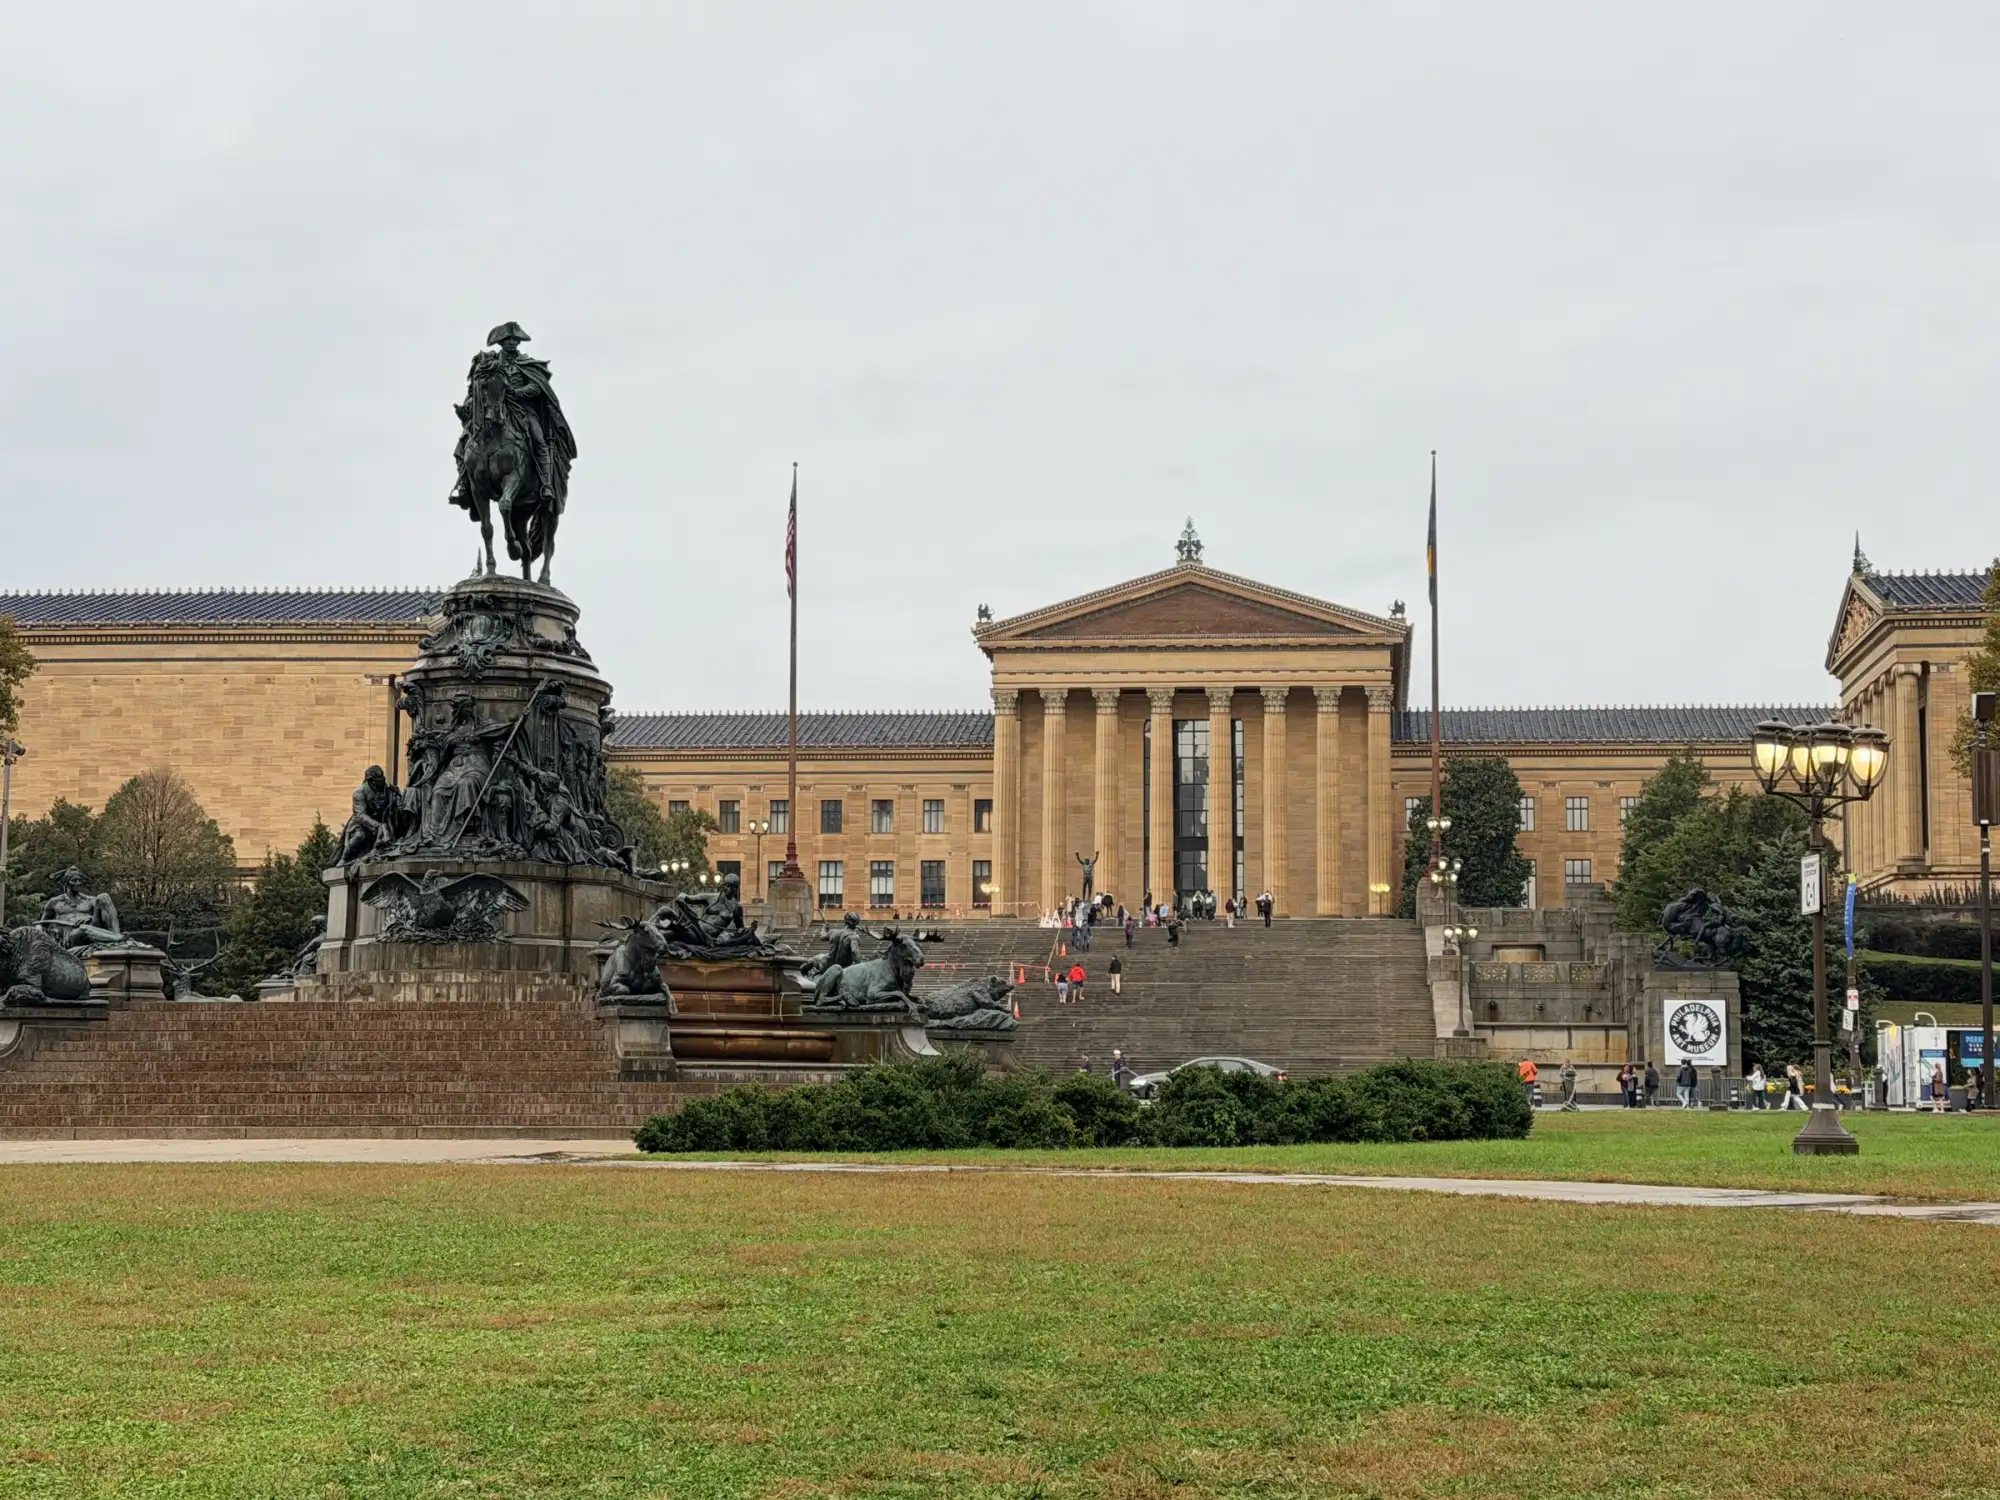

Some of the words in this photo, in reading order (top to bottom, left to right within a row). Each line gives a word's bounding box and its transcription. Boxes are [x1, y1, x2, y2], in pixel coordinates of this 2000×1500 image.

[1806, 881, 1816, 907] C-1
[1671, 1004, 1720, 1027] PHILADELPHIA
[1672, 1034, 1686, 1048] ART
[1686, 1034, 1719, 1053] MUSEUM
